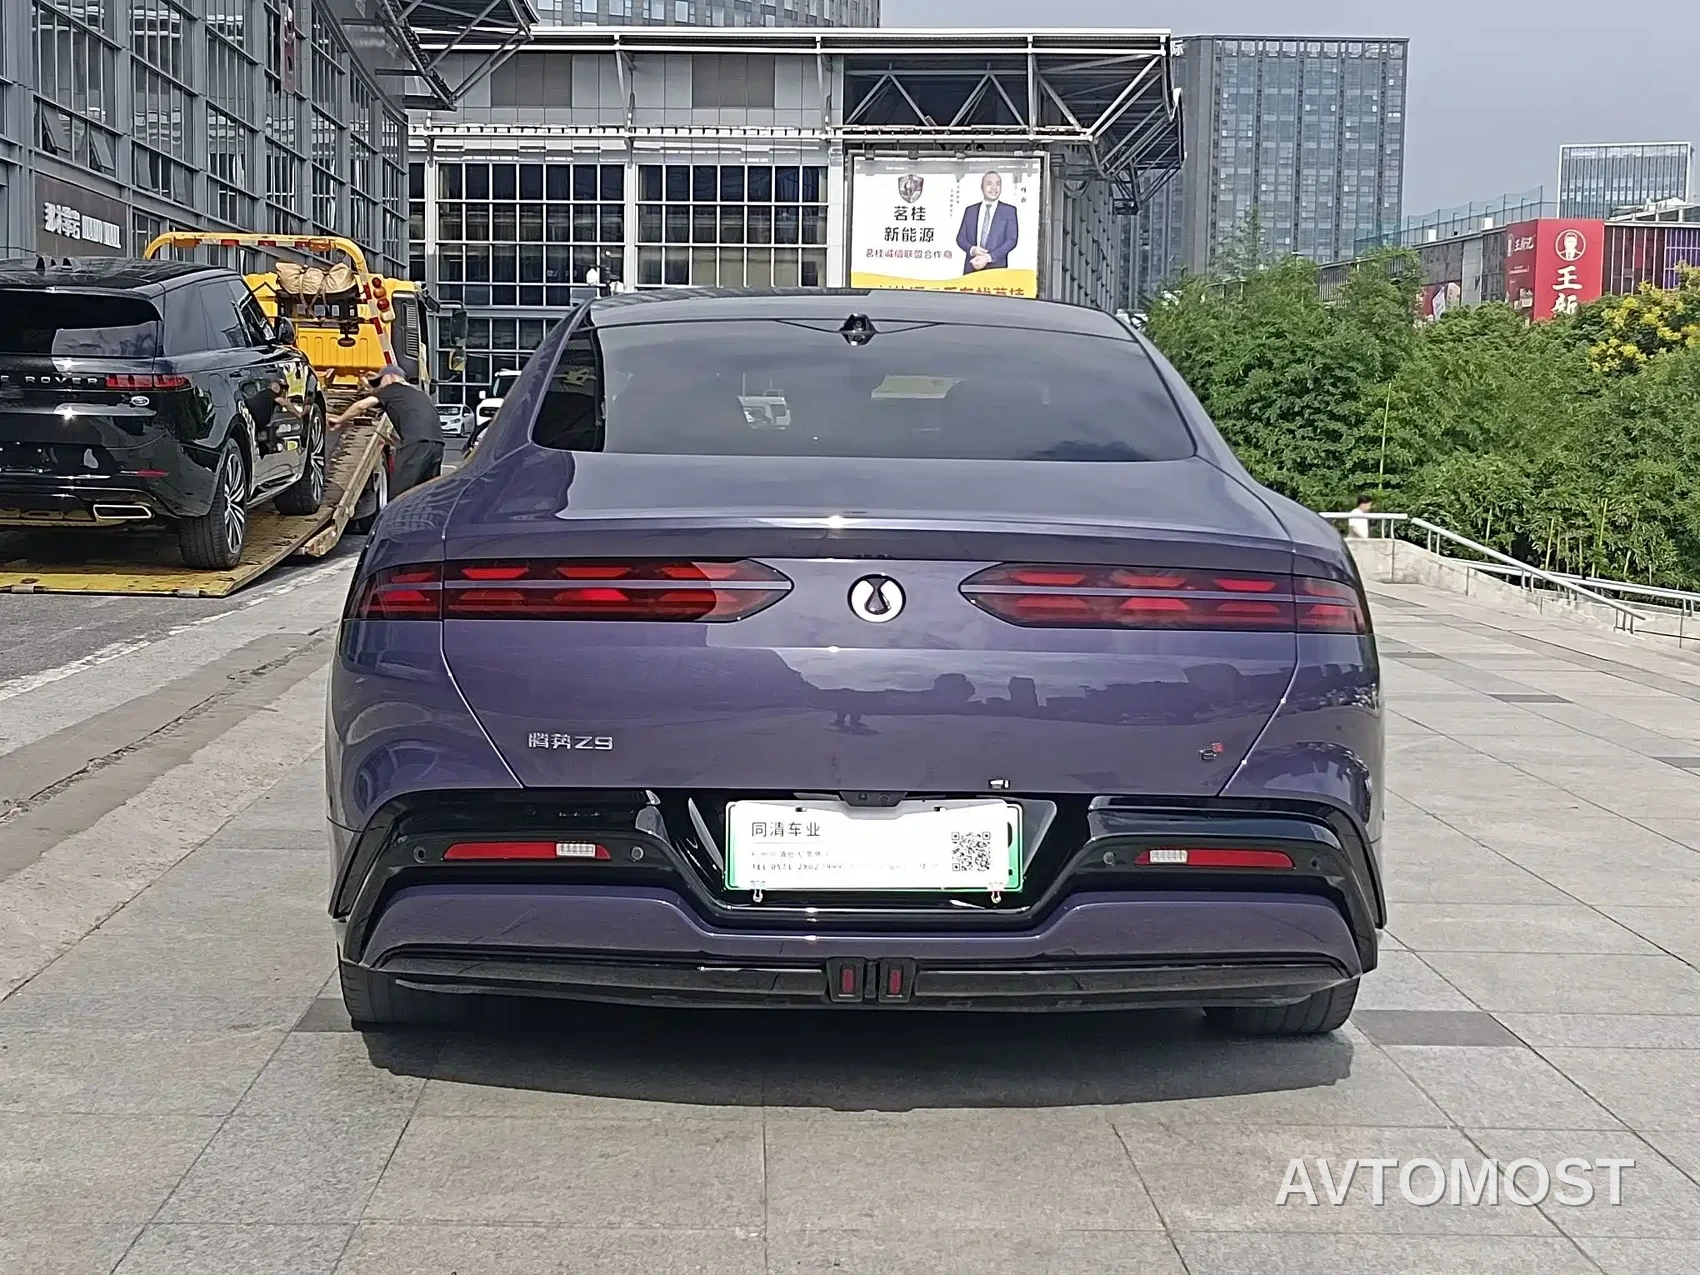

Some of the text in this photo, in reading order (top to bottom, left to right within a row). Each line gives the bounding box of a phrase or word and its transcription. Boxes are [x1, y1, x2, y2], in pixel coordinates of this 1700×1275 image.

[894, 205, 926, 221] 茗桂
[884, 226, 935, 243] 新能源
[25, 376, 98, 385] ROVER
[751, 821, 821, 837] 同清车业
